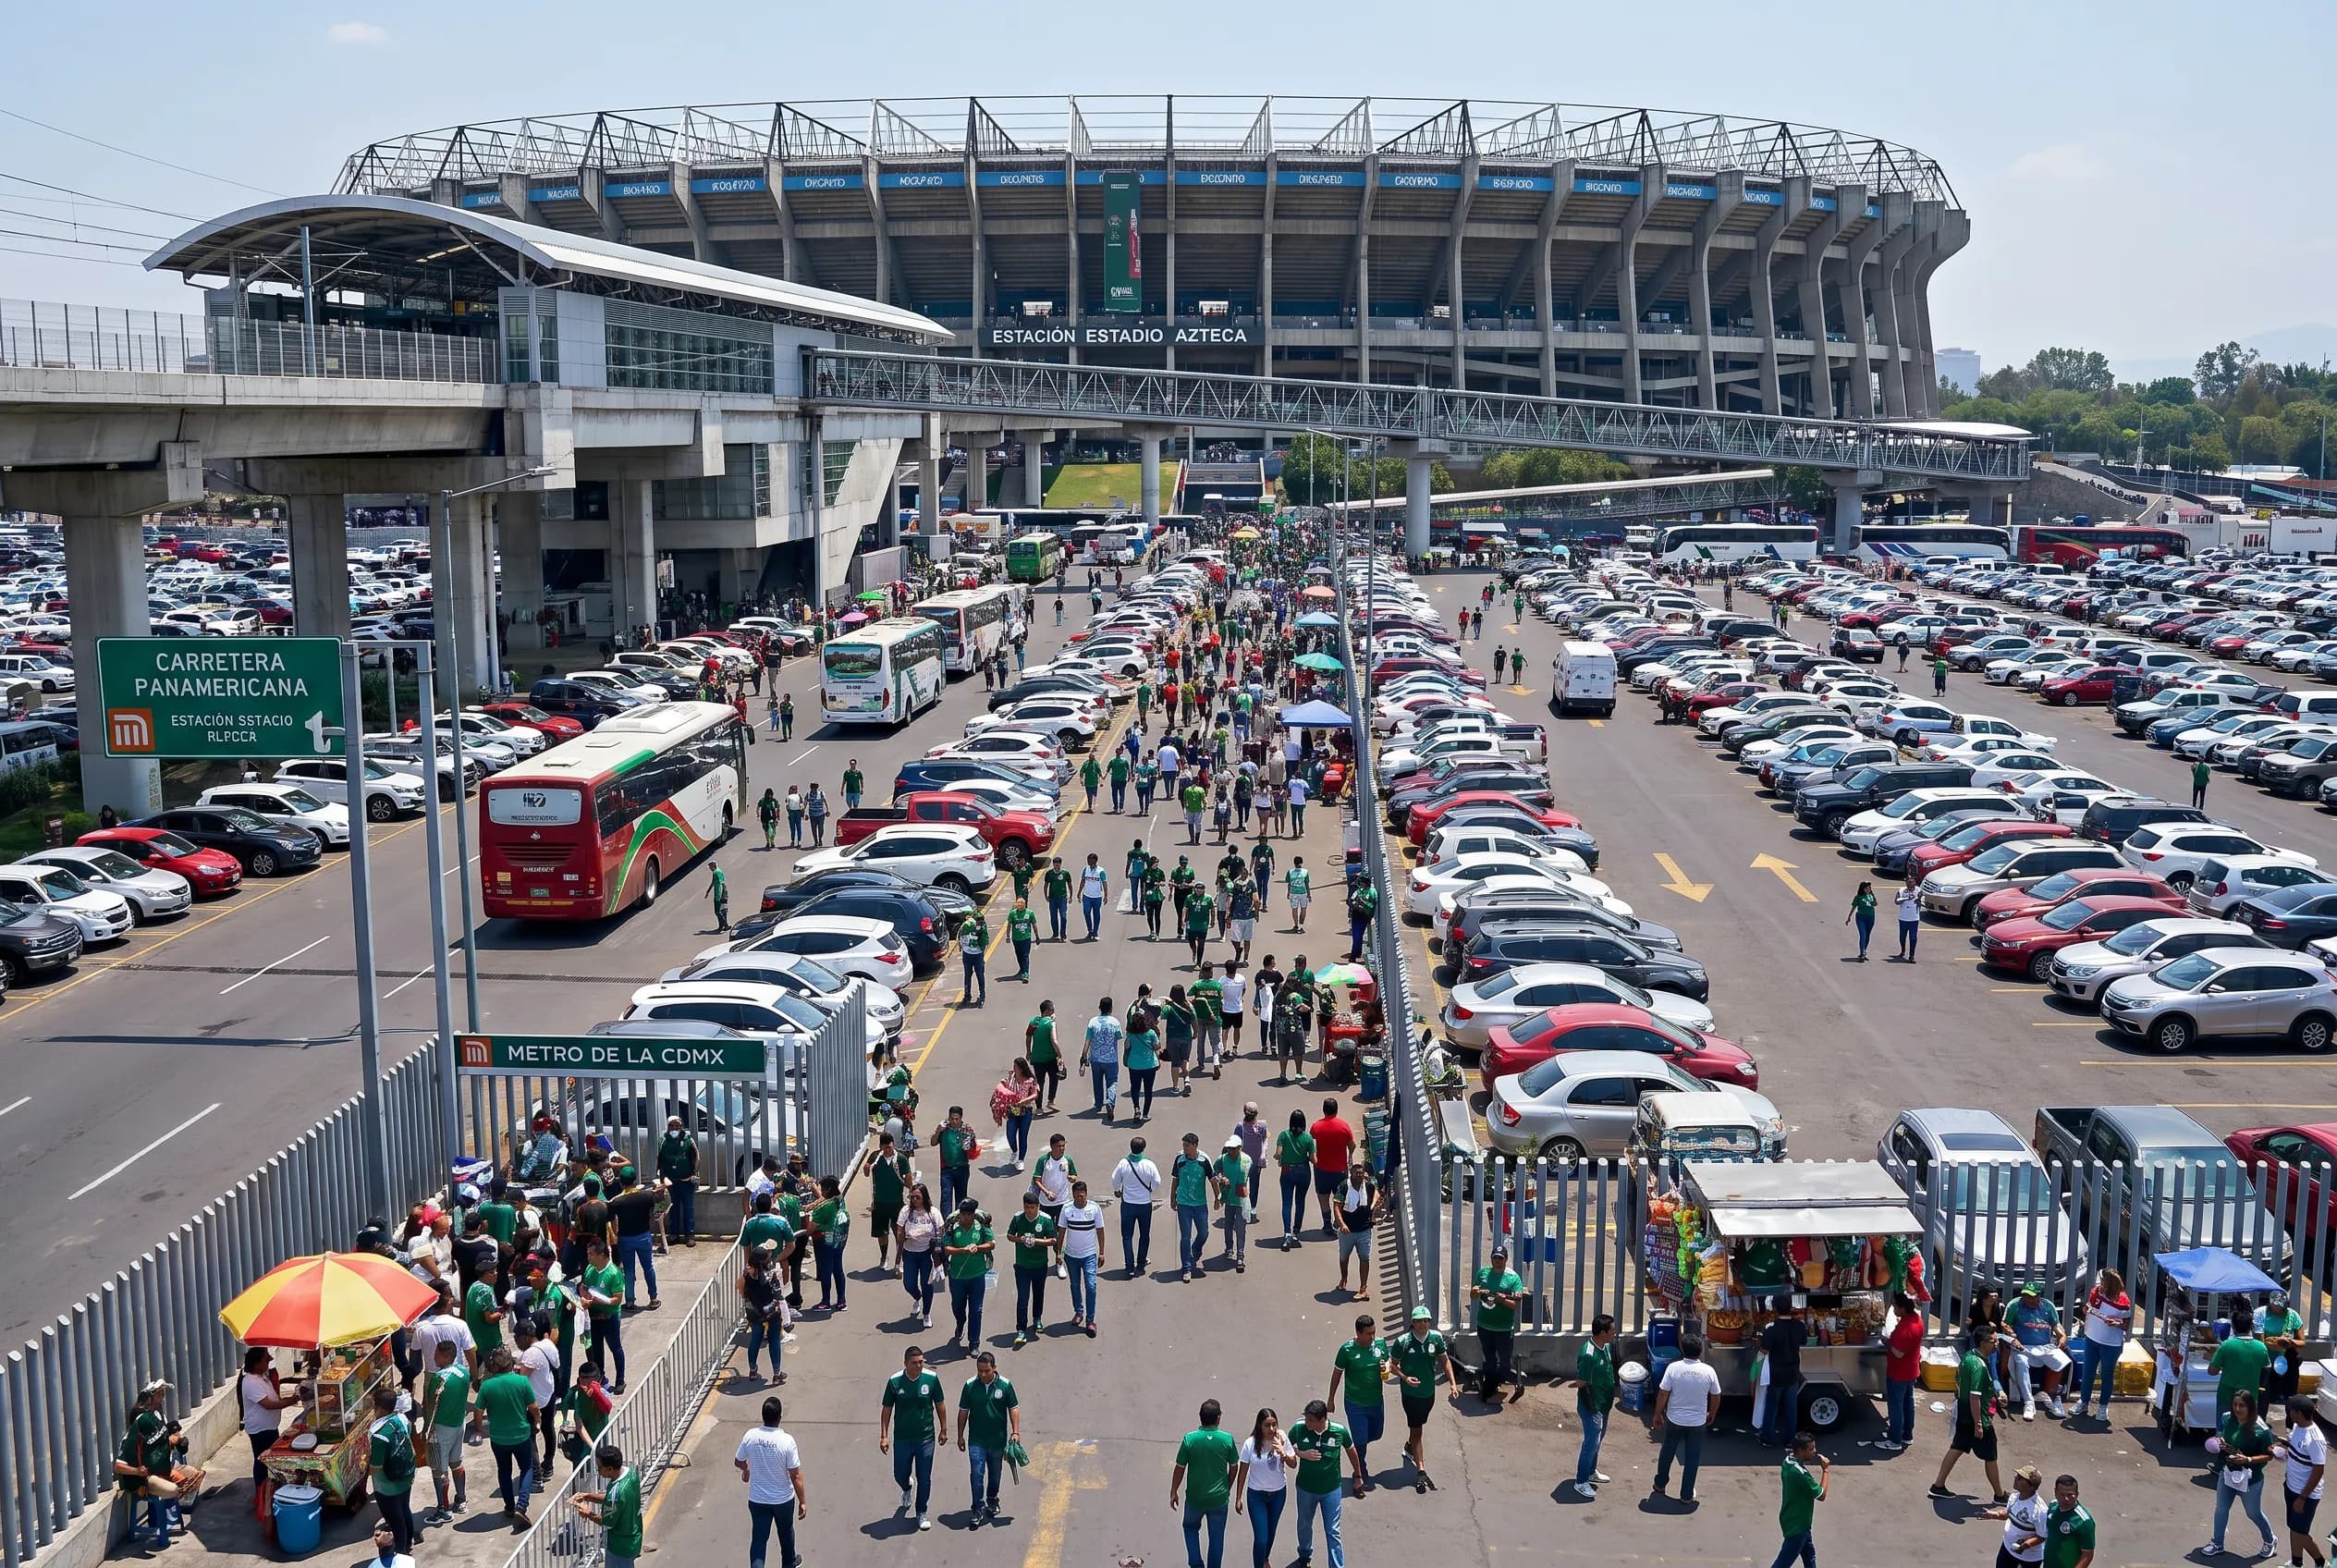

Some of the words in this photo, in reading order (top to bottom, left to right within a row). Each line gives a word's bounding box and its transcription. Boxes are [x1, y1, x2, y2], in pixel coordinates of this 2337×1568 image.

[993, 326, 1075, 343] ESTACIÓN
[1086, 328, 1163, 343] ESTADIO
[1176, 328, 1247, 343] AZTECA
[156, 653, 285, 671] CARRETERA
[135, 678, 308, 696] PANAMERICANA
[171, 713, 234, 726] ESTACIÓN
[239, 715, 293, 726] SSTACIO
[508, 1045, 583, 1062] METRO
[592, 1047, 619, 1063] DE
[627, 1047, 655, 1063] LA
[662, 1047, 725, 1065] CDMX
